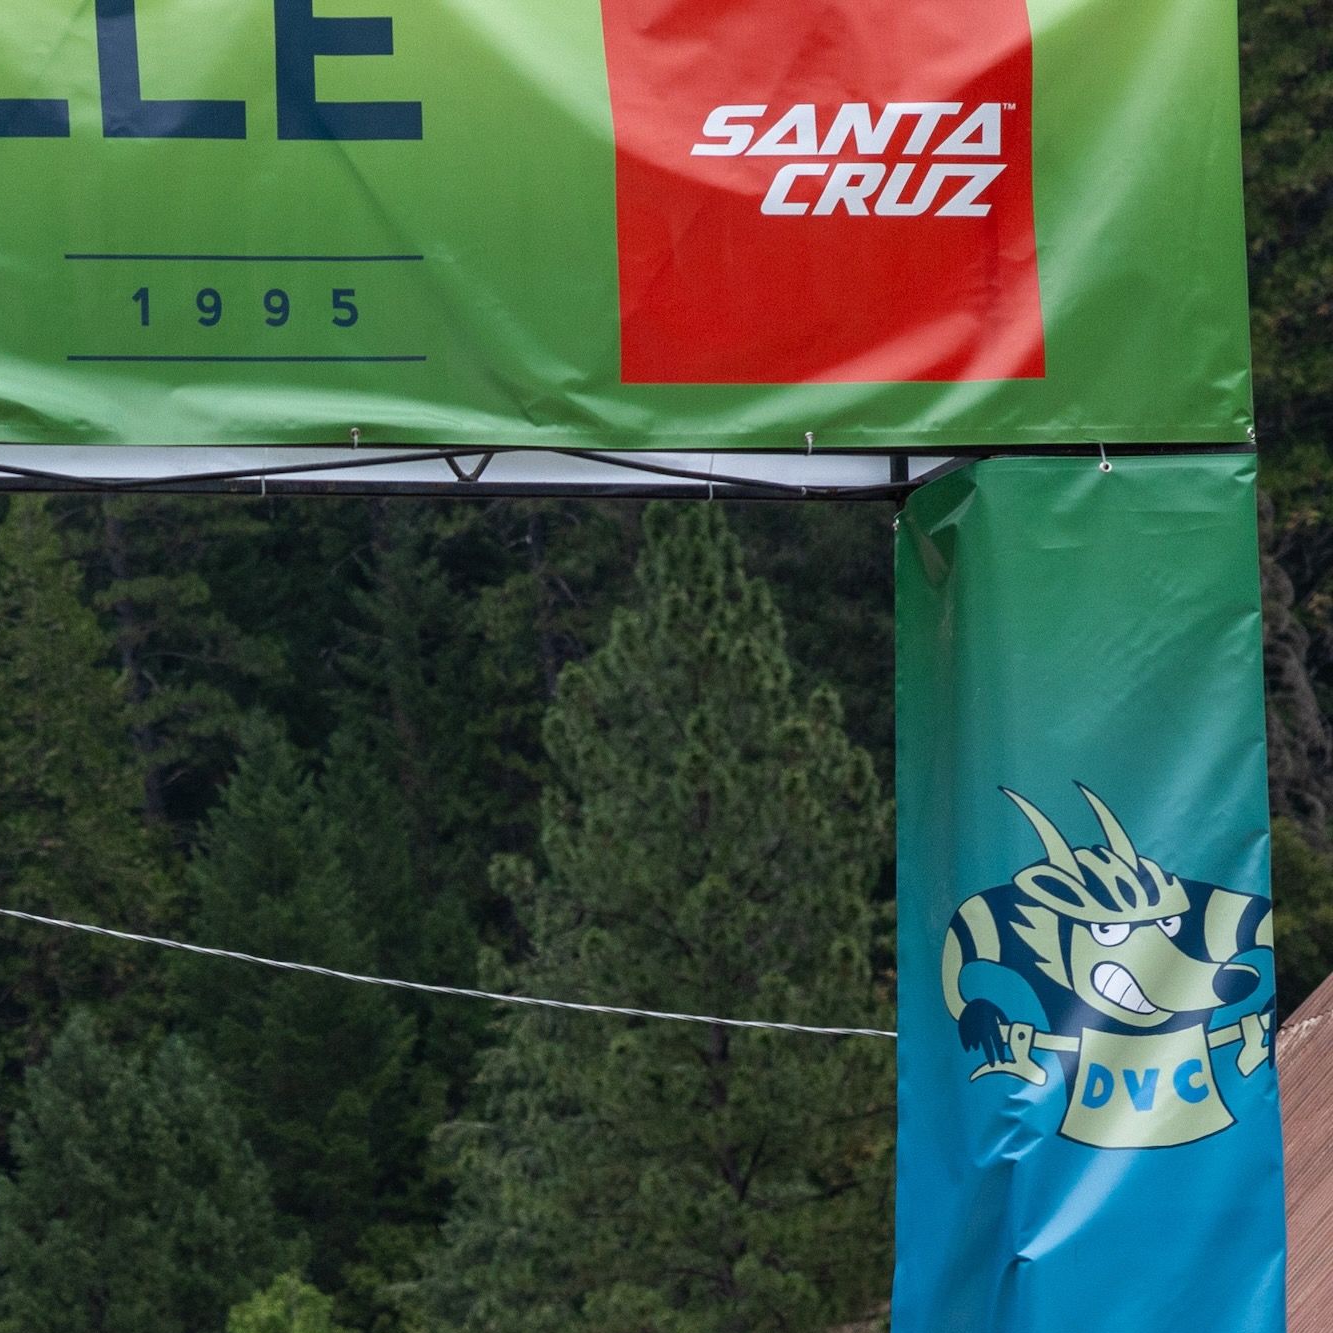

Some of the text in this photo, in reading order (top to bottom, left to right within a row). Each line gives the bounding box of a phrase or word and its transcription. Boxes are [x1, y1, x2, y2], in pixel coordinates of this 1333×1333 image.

[691, 102, 1002, 156] SANTA
[760, 163, 1008, 217] CRUZ
[132, 287, 359, 328] 1995
[1081, 1058, 1210, 1112] DVC
